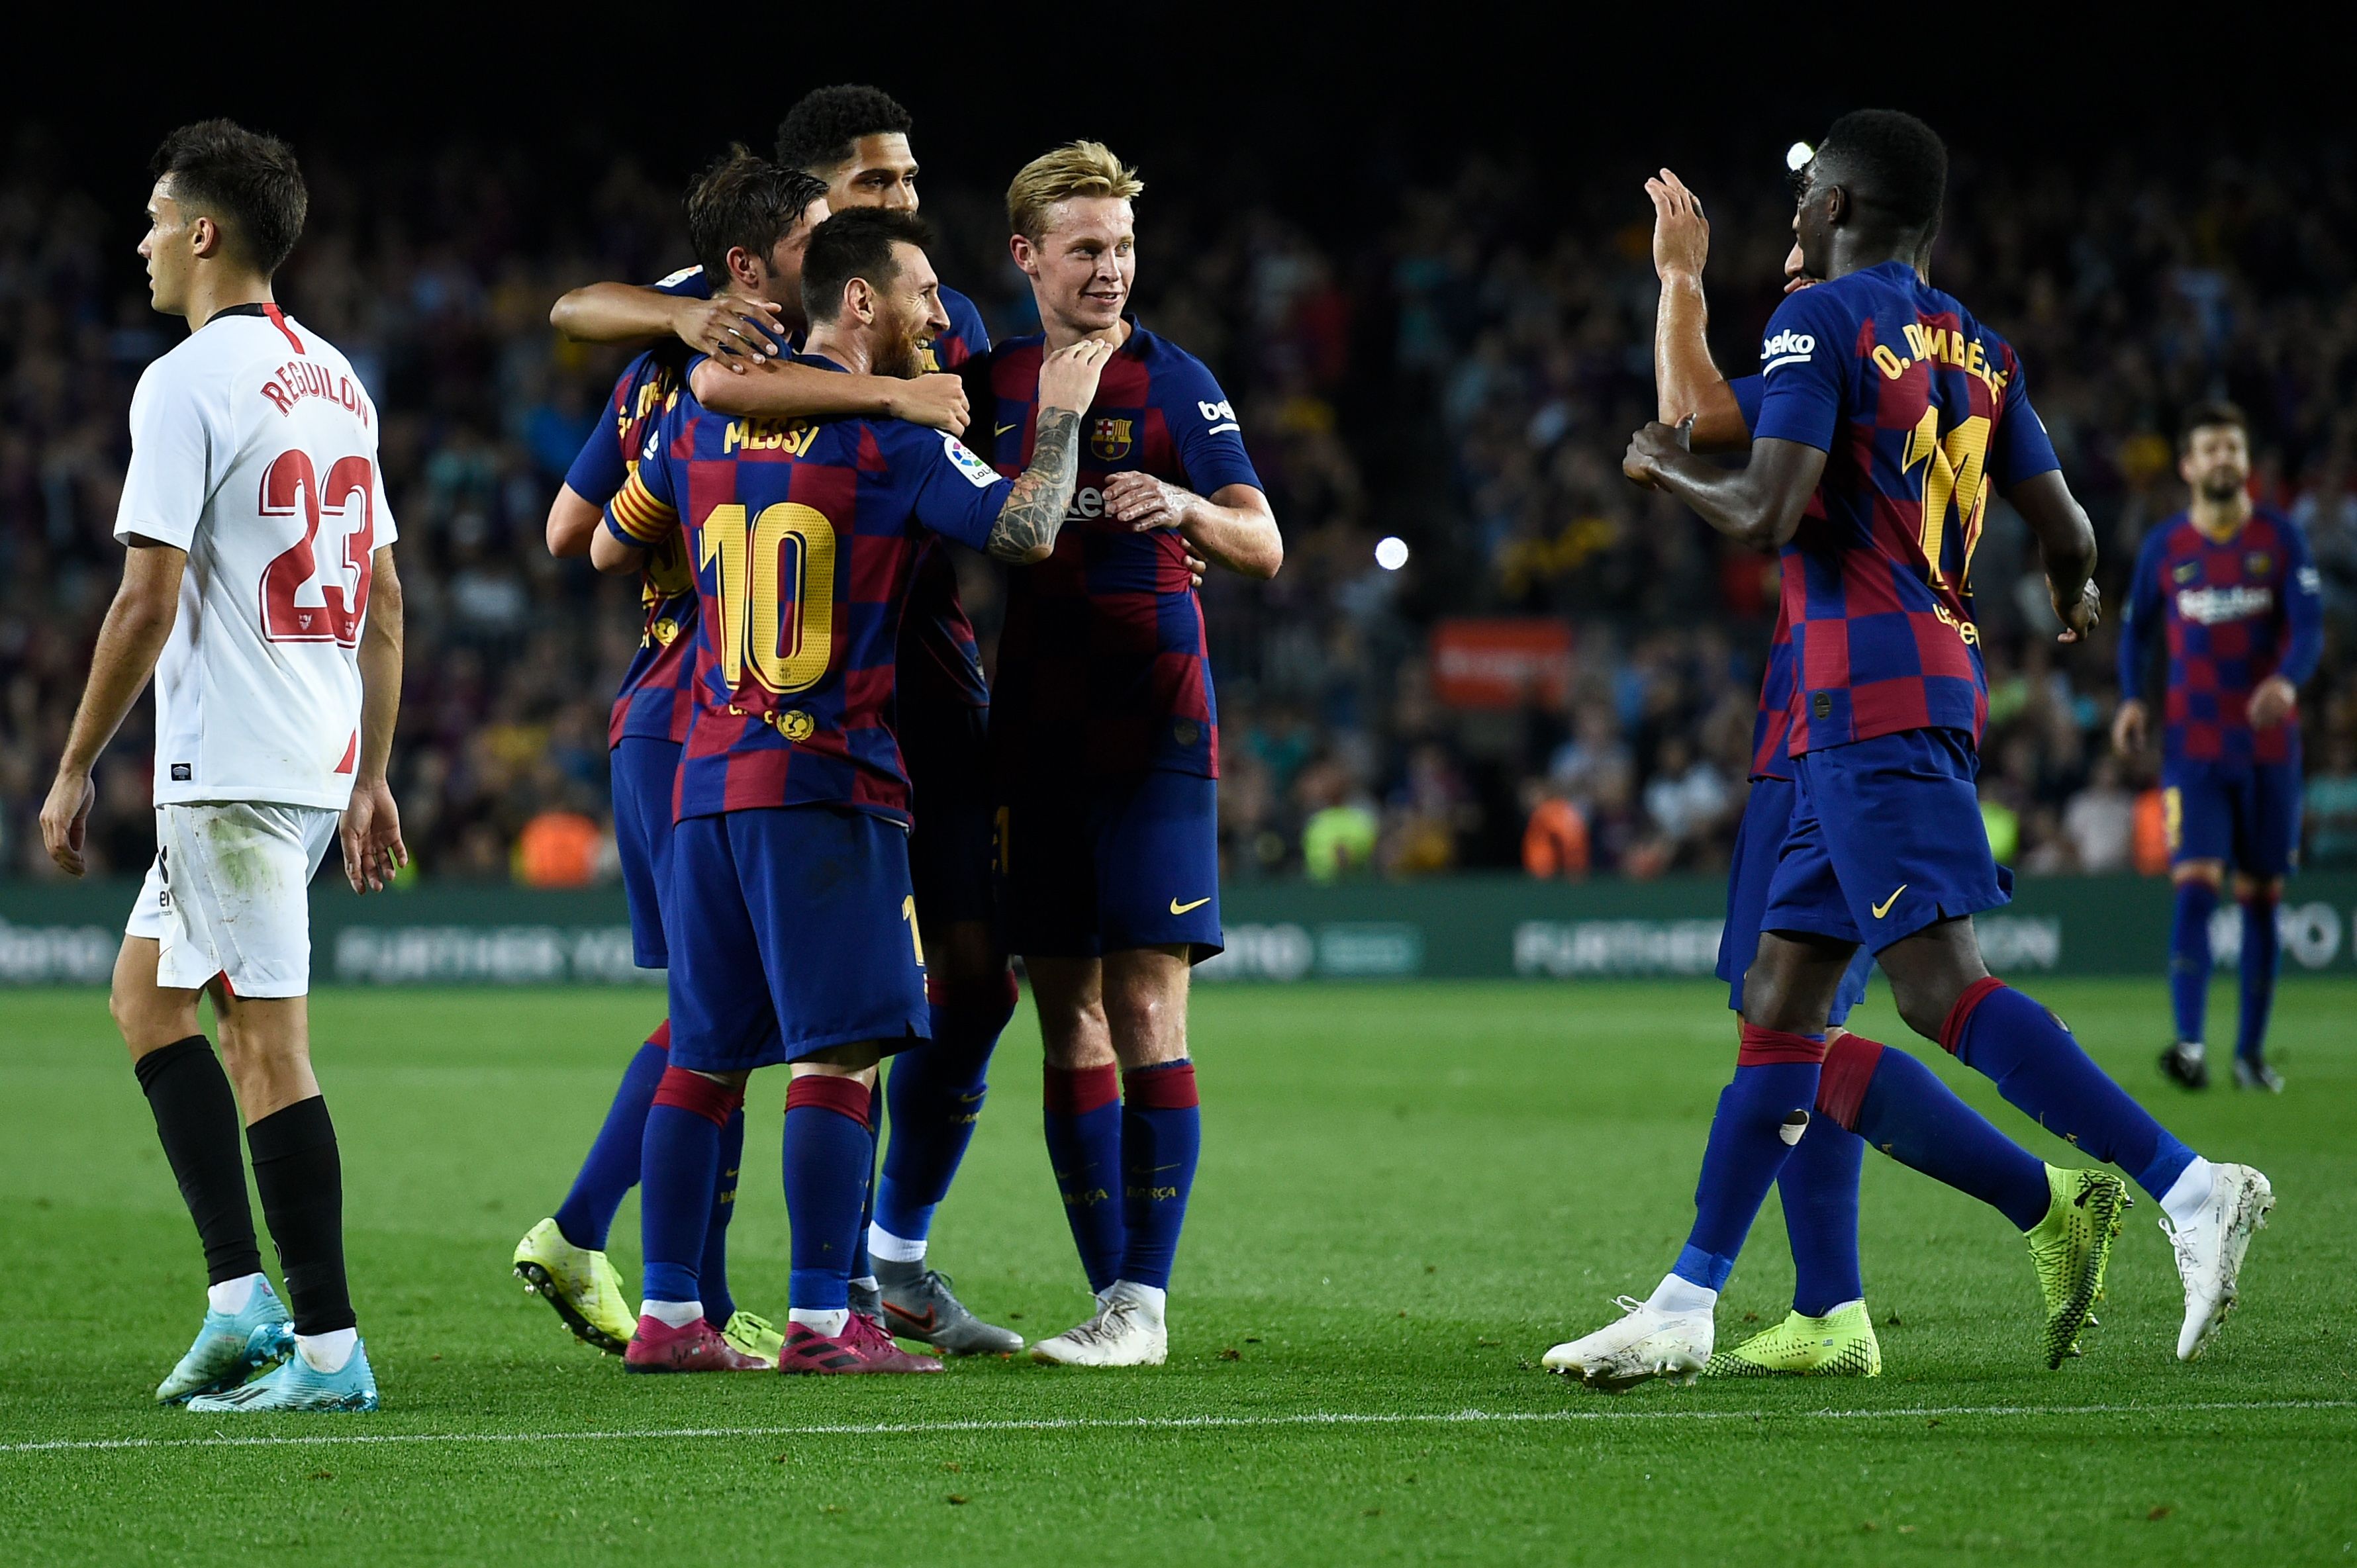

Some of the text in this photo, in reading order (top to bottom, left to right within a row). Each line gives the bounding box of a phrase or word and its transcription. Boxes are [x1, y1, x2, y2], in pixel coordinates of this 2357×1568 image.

[724, 418, 820, 458] MESSI
[1872, 344, 1911, 380] O.
[259, 449, 375, 649] 23
[1901, 405, 1991, 597] 11
[698, 502, 836, 694] 10
